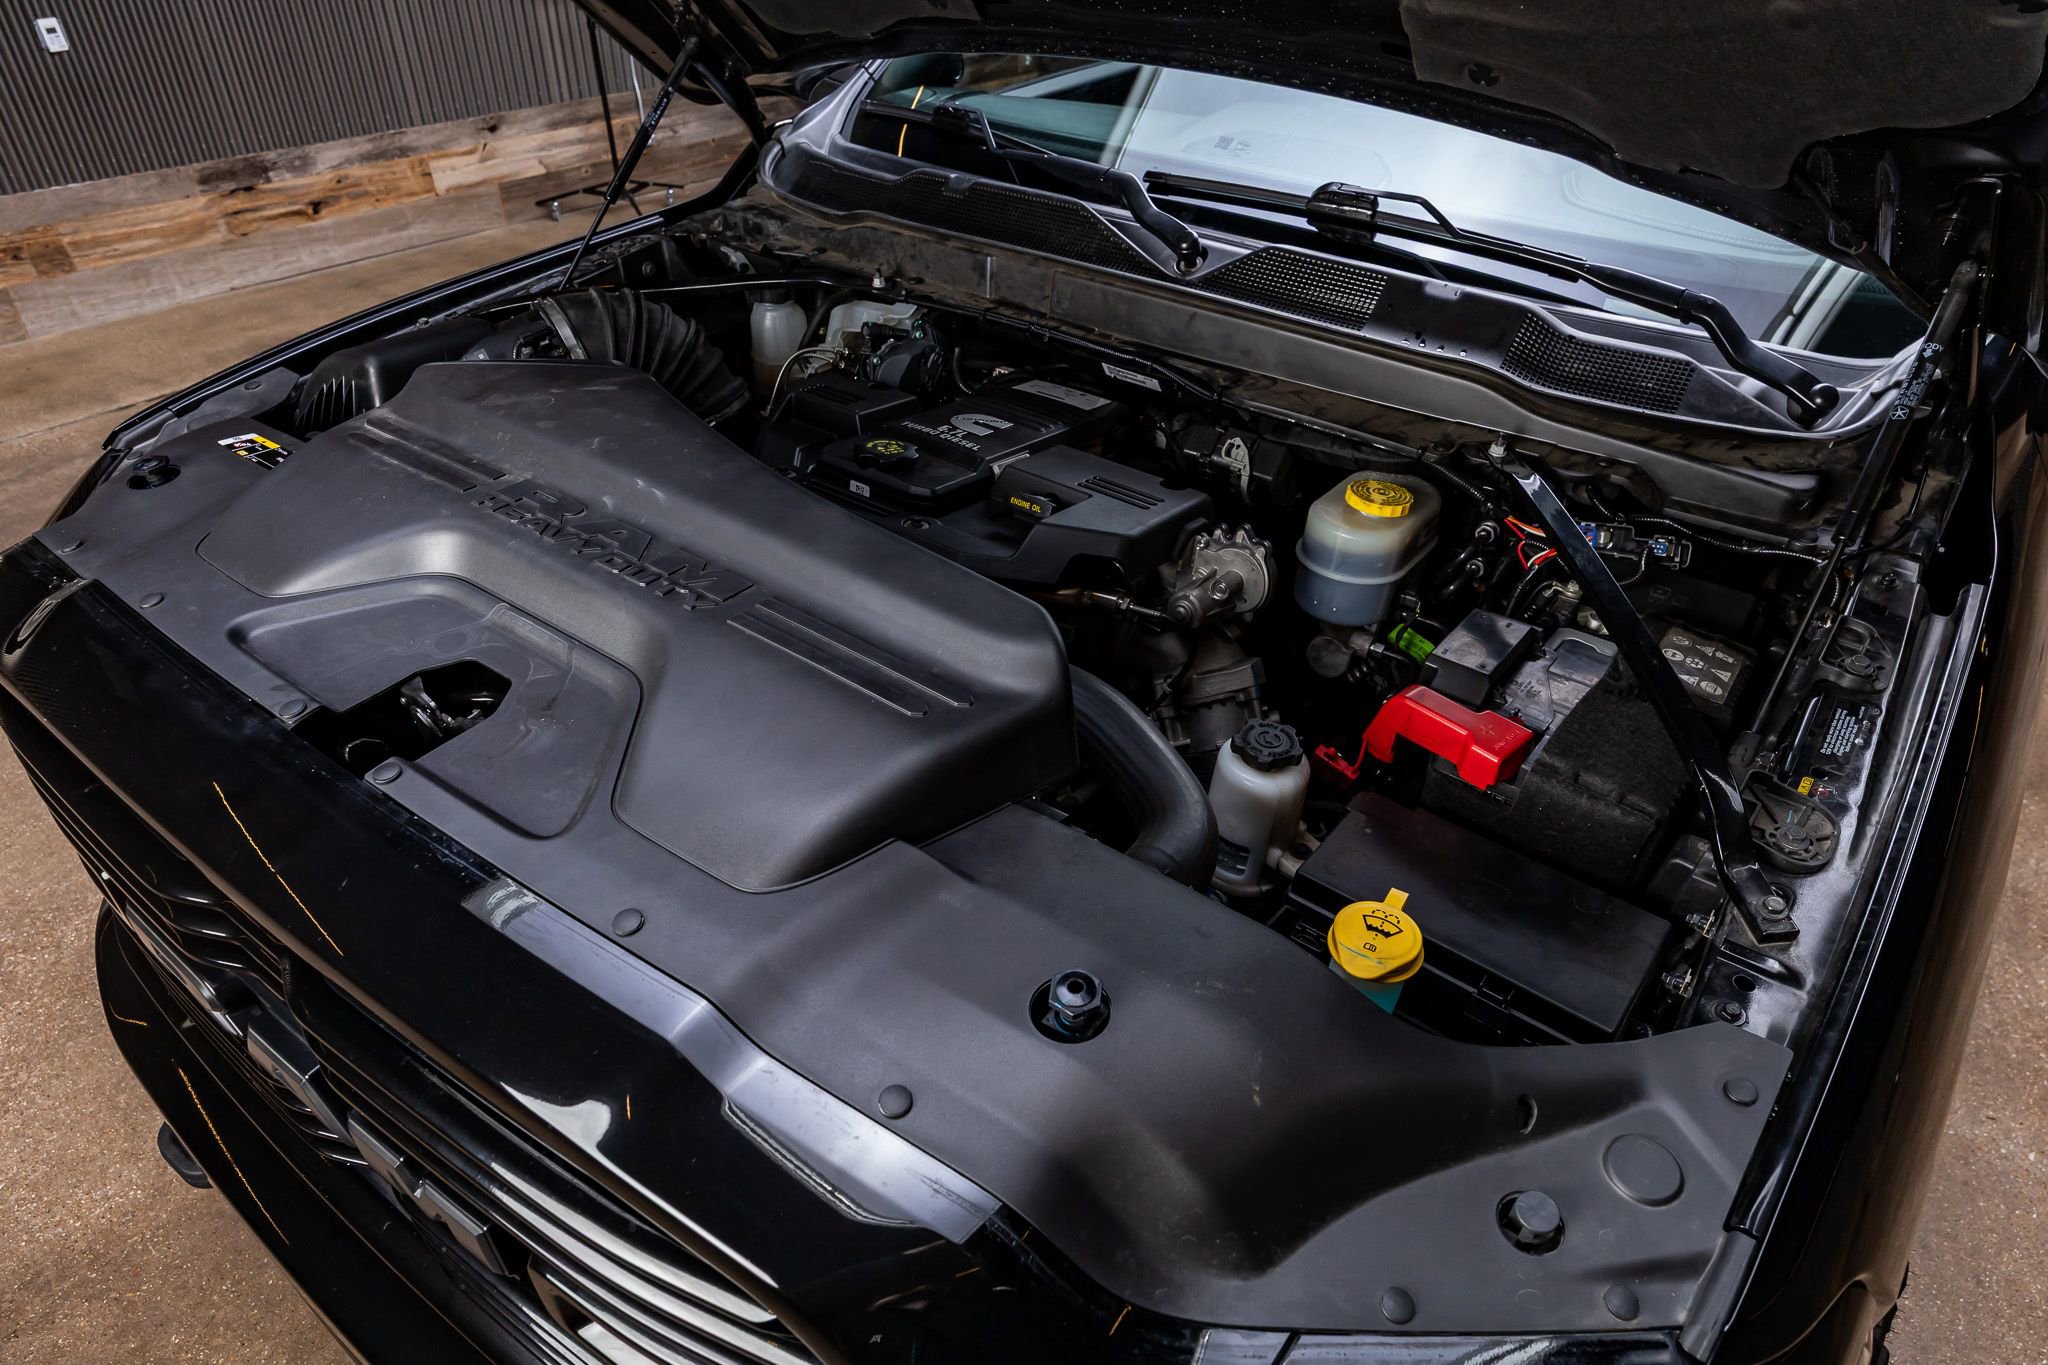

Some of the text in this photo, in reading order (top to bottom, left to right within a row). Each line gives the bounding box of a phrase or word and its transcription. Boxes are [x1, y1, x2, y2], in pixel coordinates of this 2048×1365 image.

[900, 421, 982, 452] TURBO DIESEL
[496, 479, 755, 602] RAM
[1010, 496, 1041, 513] ENGINE OIL
[471, 495, 723, 611] HEAVY DUTY
